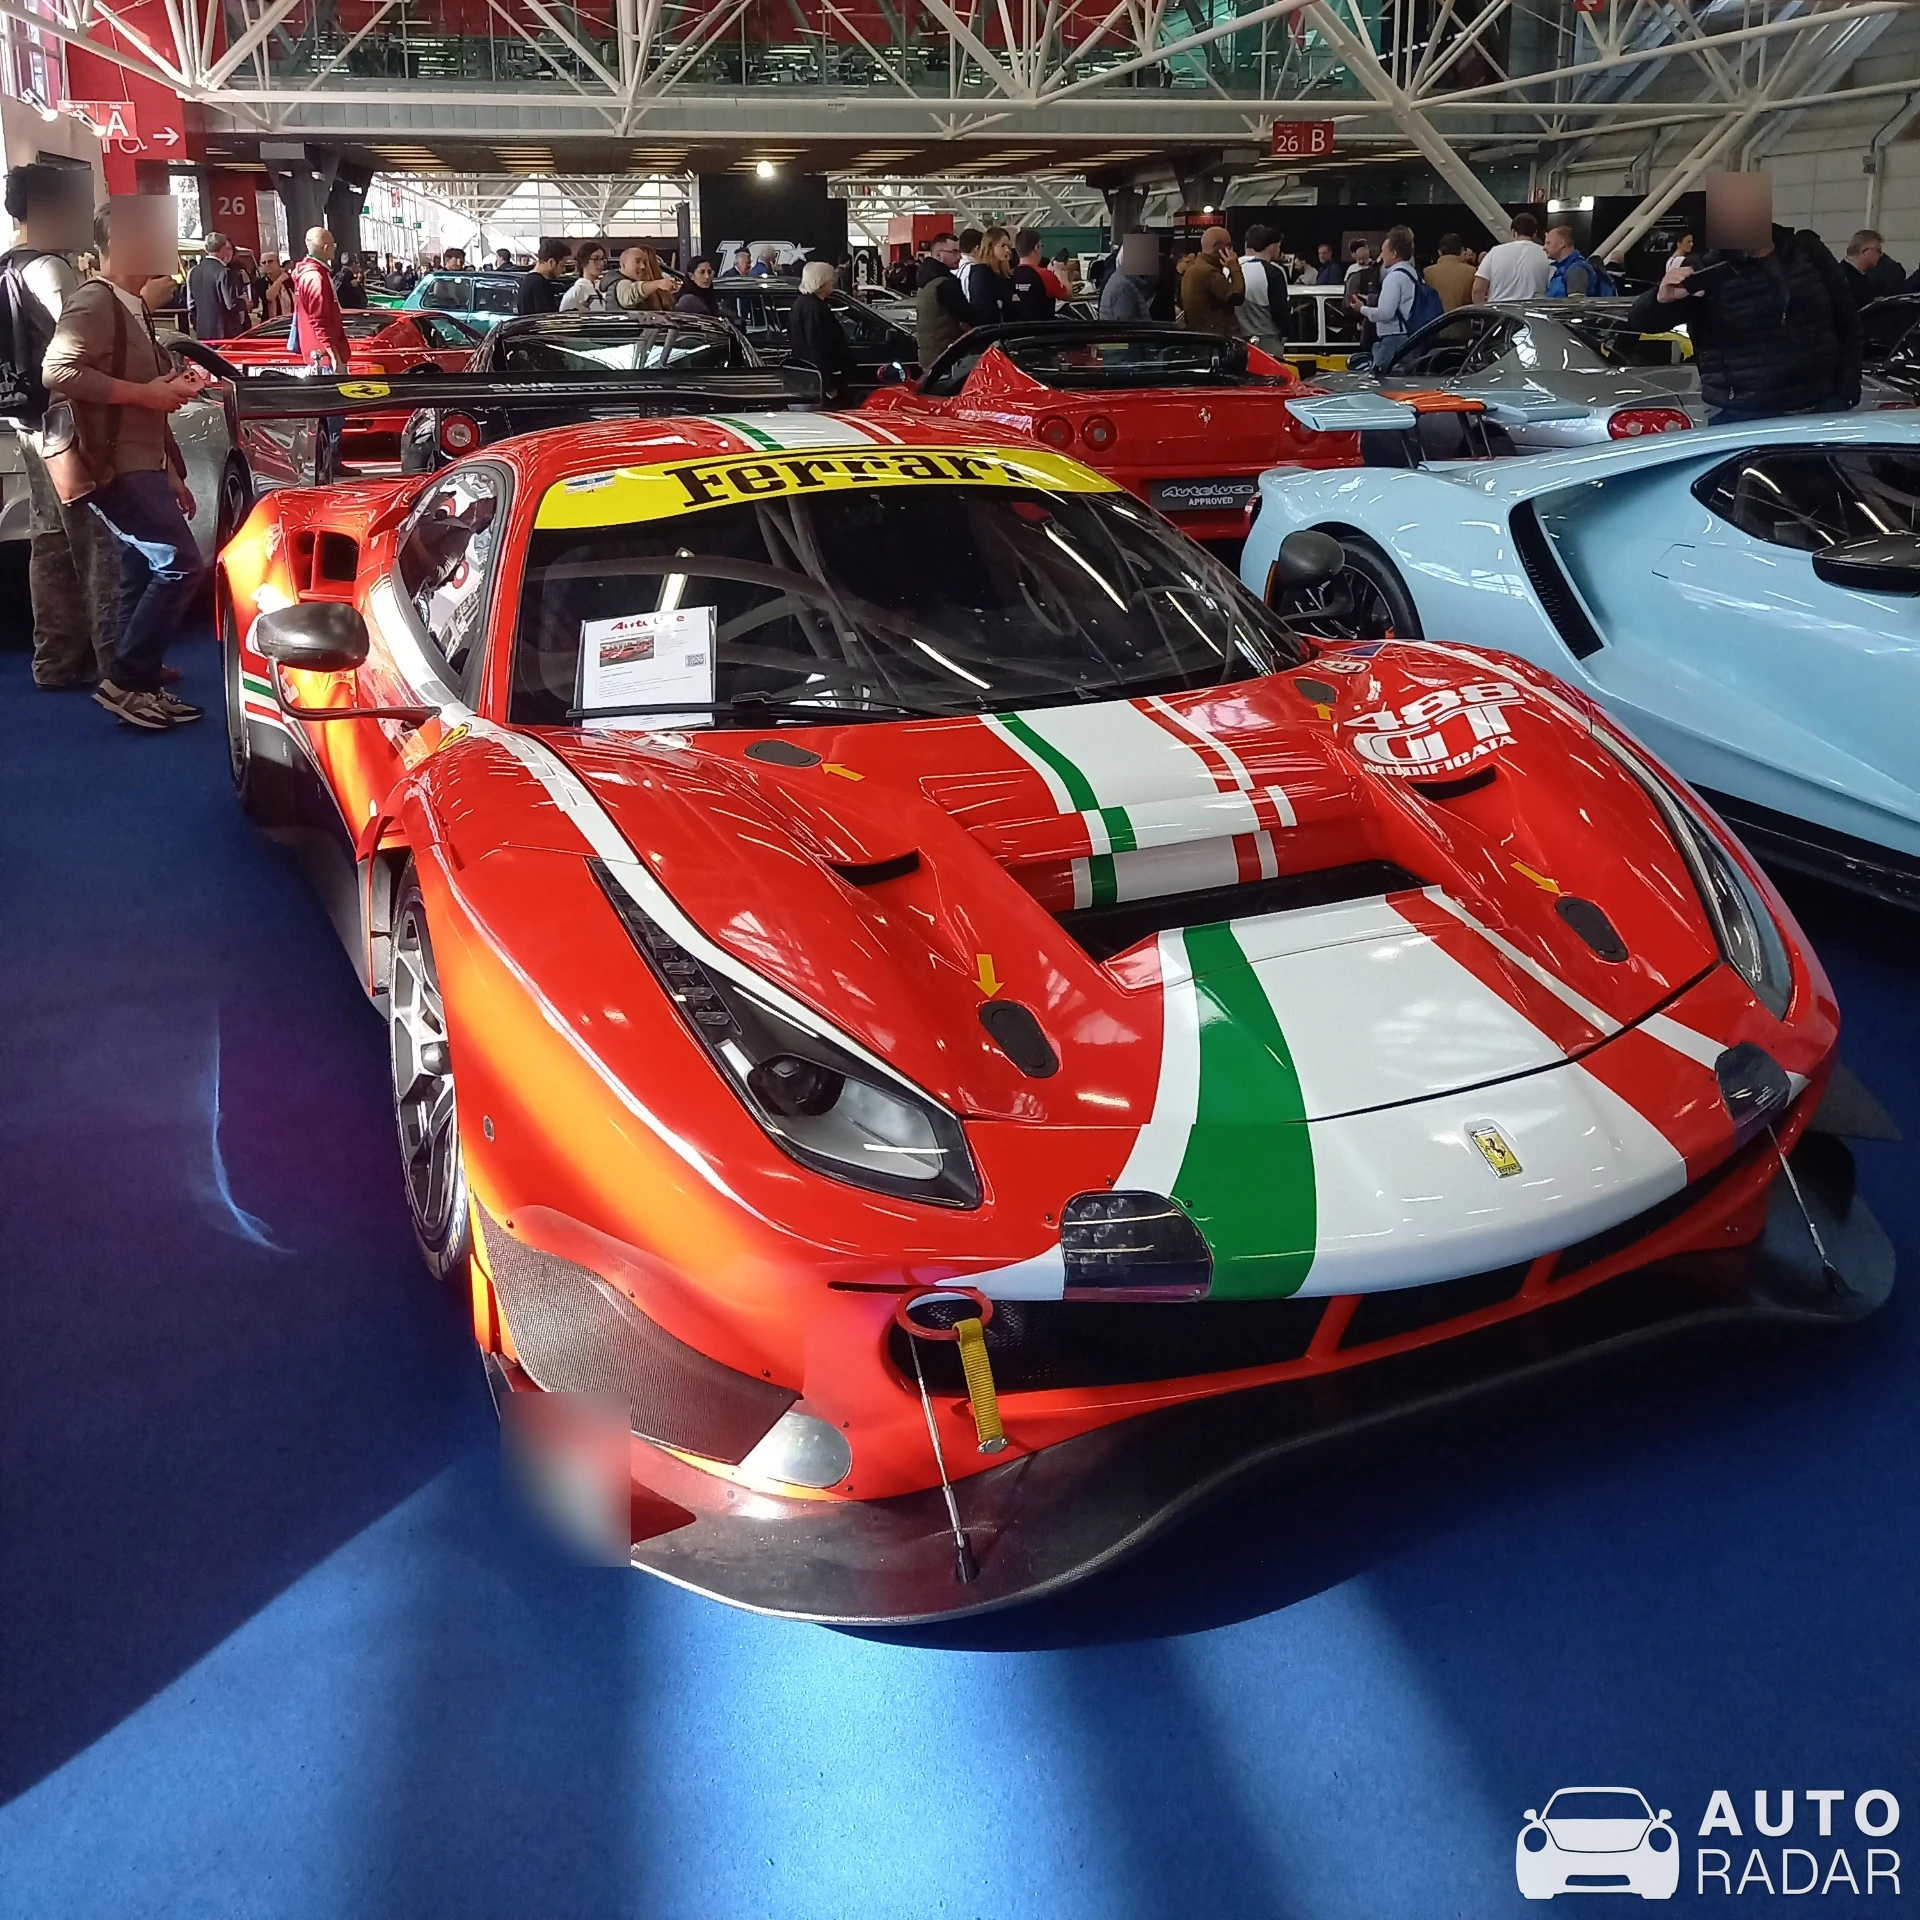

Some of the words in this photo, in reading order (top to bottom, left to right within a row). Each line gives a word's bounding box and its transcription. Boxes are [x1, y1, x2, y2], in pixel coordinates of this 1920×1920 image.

[106, 111, 129, 137] A
[1276, 135, 1299, 152] 26
[1311, 129, 1325, 152] B
[218, 196, 246, 216] 26
[663, 447, 1033, 508] Ferrari
[1188, 496, 1234, 506] APPROVED
[1343, 682, 1521, 731] 488
[1353, 699, 1526, 765] GT
[1363, 735, 1519, 776] MODIFICATA
